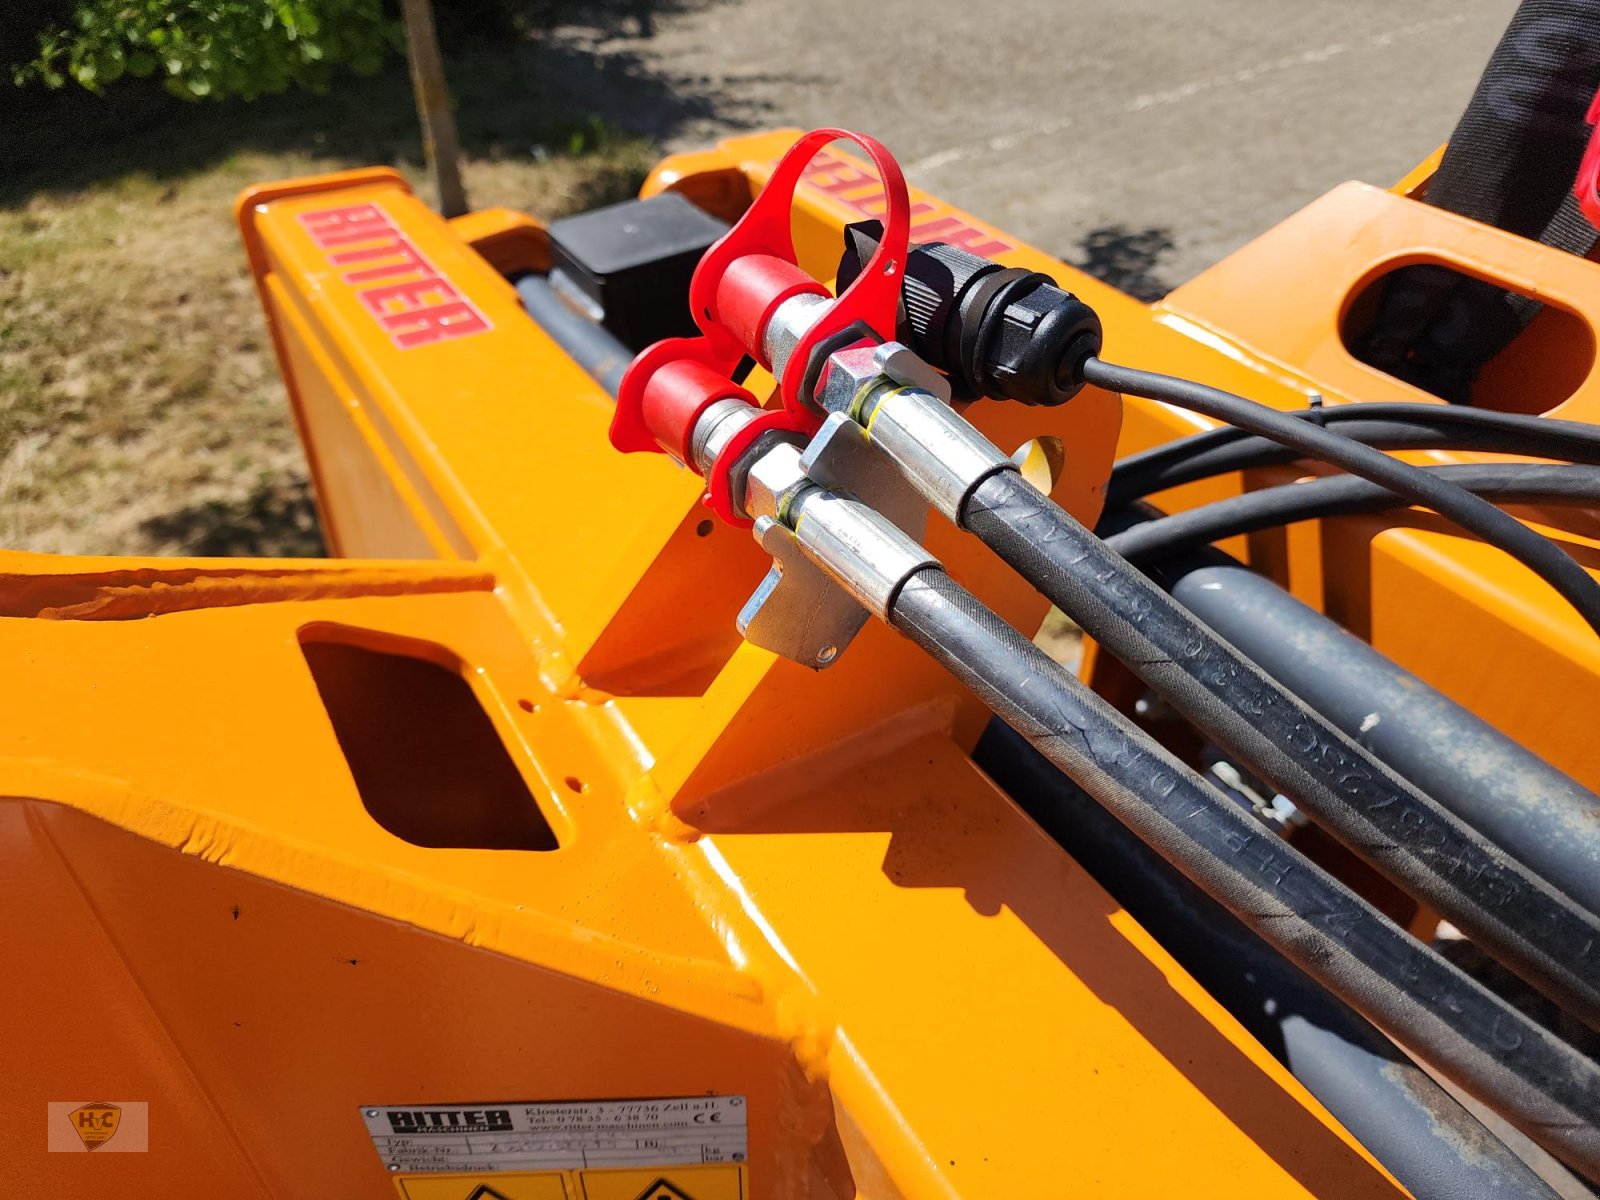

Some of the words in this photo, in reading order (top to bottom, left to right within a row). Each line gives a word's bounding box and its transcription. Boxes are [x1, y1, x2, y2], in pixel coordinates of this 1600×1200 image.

[297, 201, 495, 351] RITTER
[663, 1102, 689, 1112] Zell
[387, 1109, 511, 1127] RITTER
